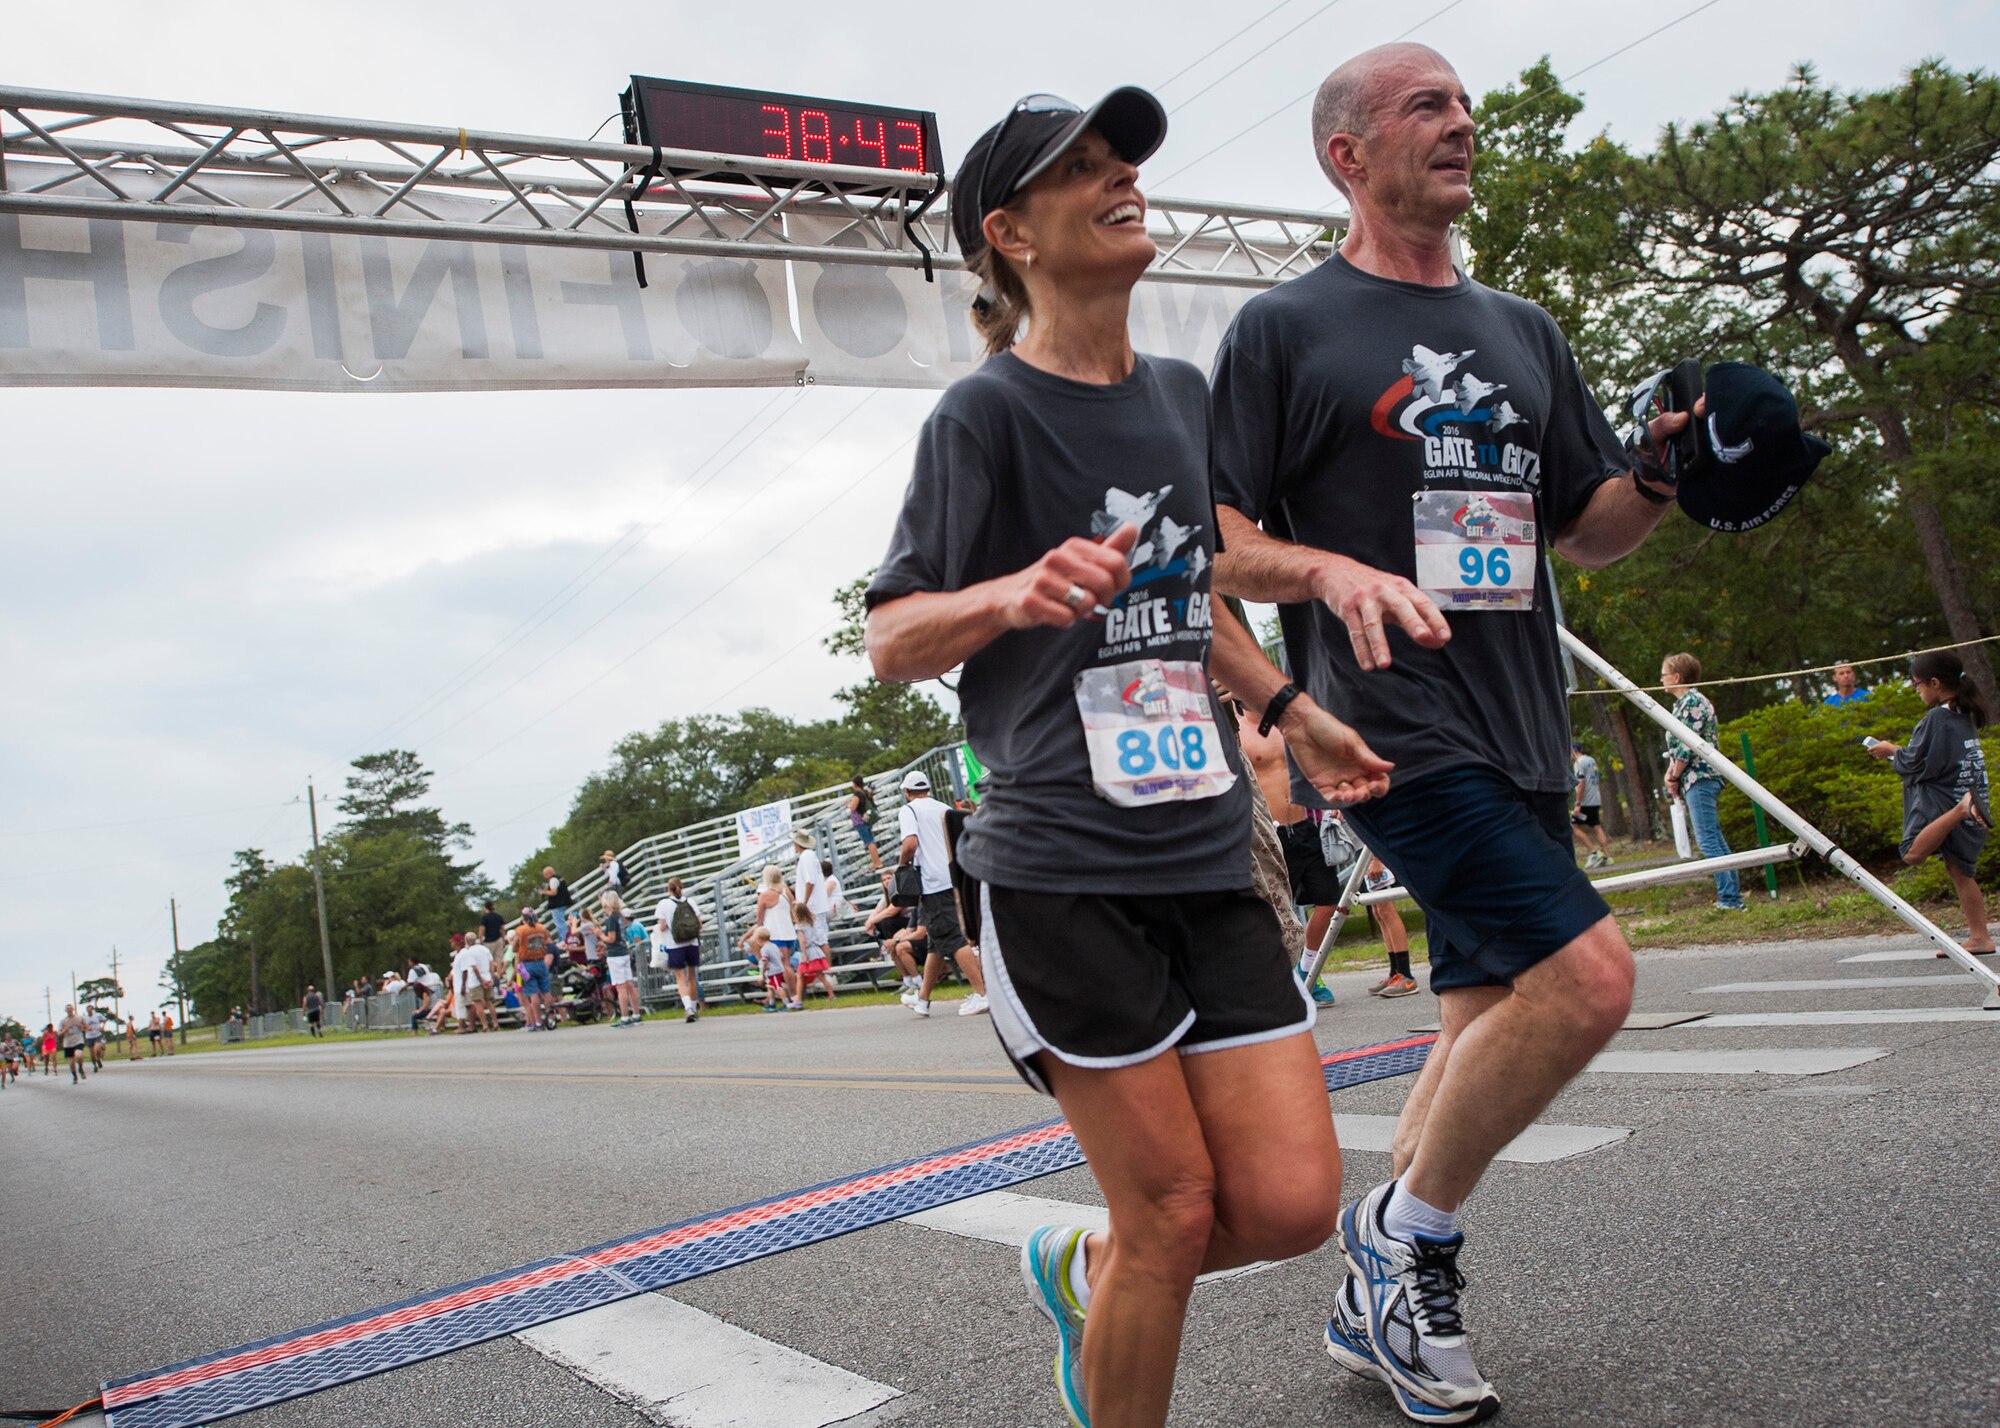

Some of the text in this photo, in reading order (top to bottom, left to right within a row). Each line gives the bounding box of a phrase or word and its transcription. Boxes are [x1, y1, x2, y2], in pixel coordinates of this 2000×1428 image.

[1442, 426, 1460, 436] 2016
[1424, 436, 1477, 469] GATE
[1477, 443, 1498, 465] TO
[1424, 470, 1444, 479] EGLIN
[1445, 469, 1459, 478] AFB
[1710, 485, 1798, 531] U.S. AIR FORCE
[1466, 526, 1484, 537] GATE
[1458, 546, 1511, 587] 96
[1128, 589, 1150, 604] 2016
[1105, 597, 1172, 645] GATE
[1123, 640, 1142, 654] AFB
[1117, 725, 1207, 776] 808
